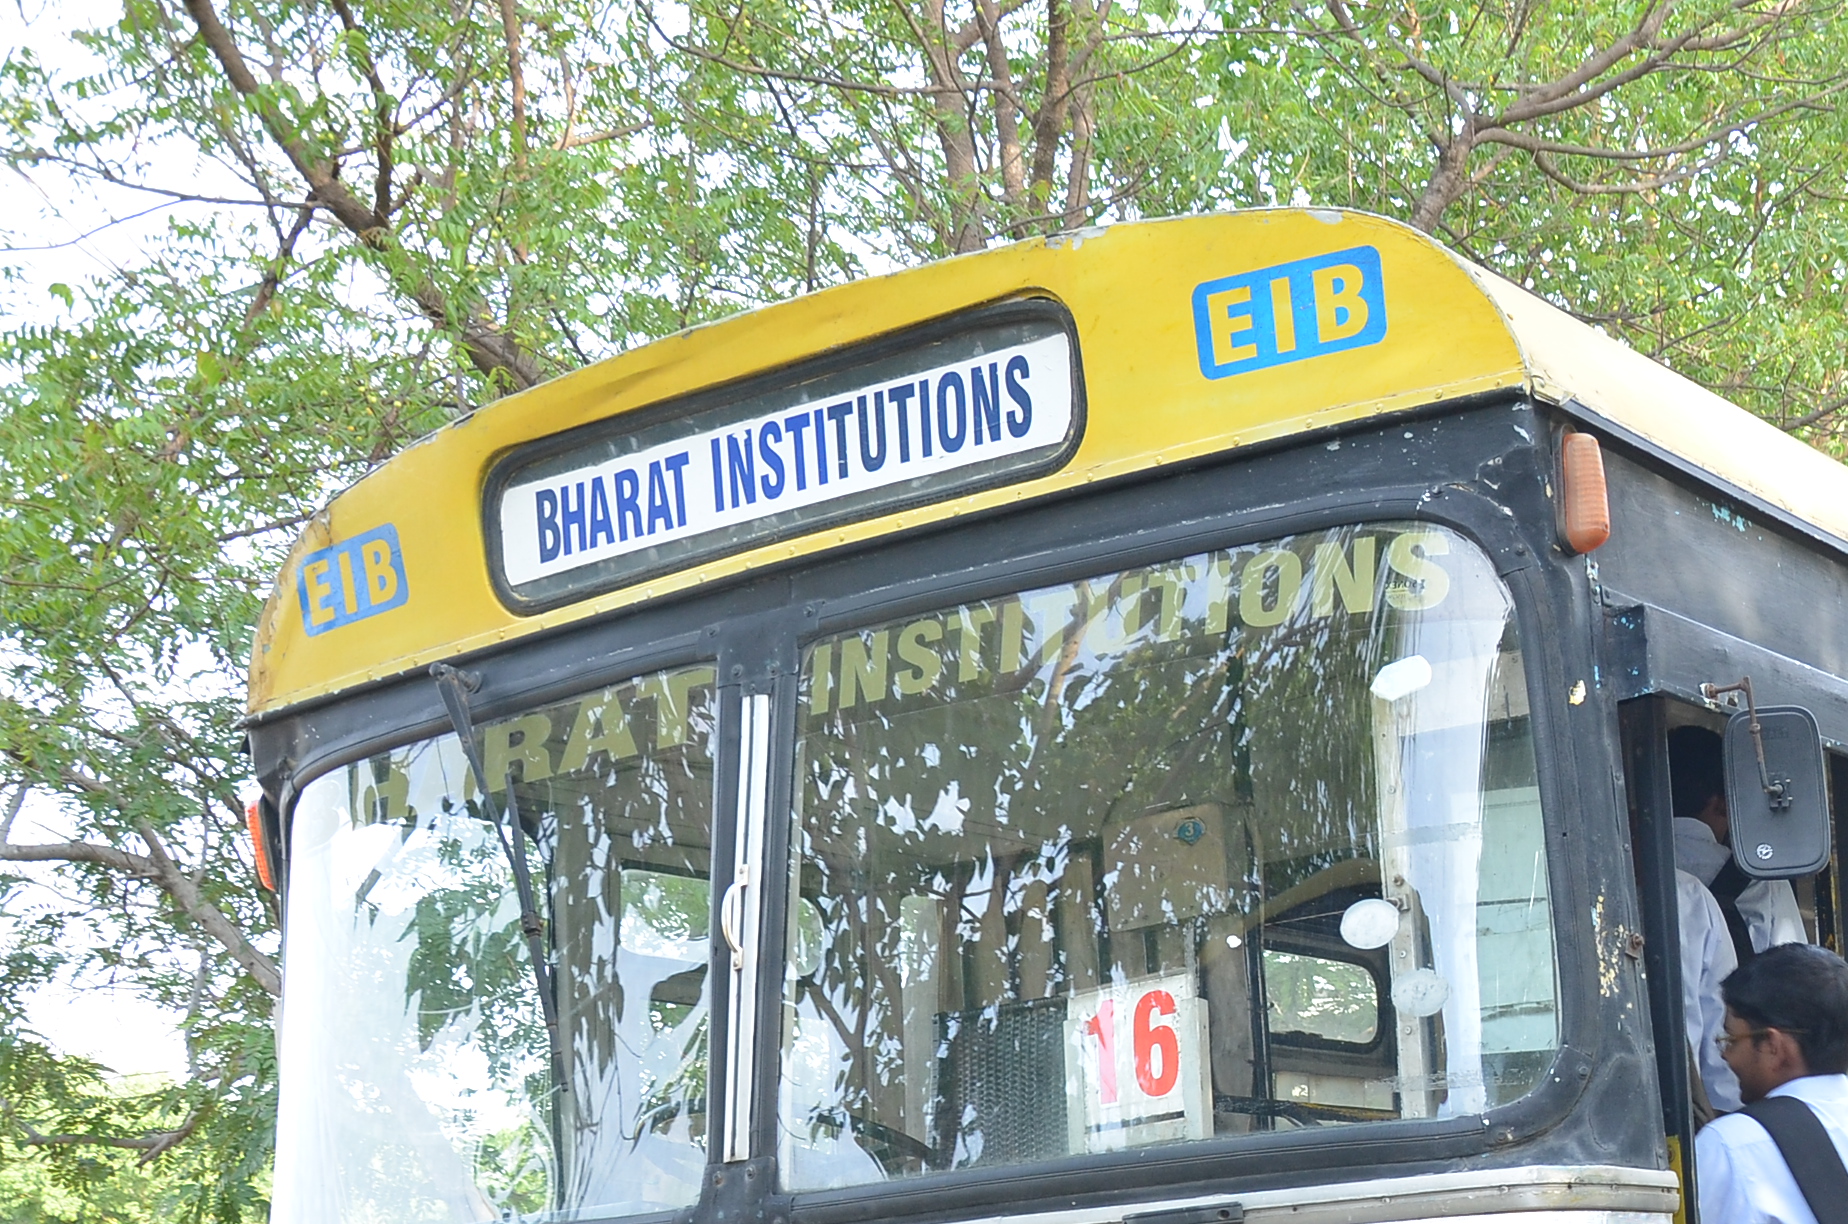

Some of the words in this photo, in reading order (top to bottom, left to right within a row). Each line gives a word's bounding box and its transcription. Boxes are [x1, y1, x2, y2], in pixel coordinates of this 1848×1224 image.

[1206, 263, 1370, 367] EIB
[535, 451, 690, 564] BHARAT
[710, 355, 1033, 513] INSTITUTIONS
[303, 538, 399, 627] EIB
[1085, 989, 1179, 1105] 16
